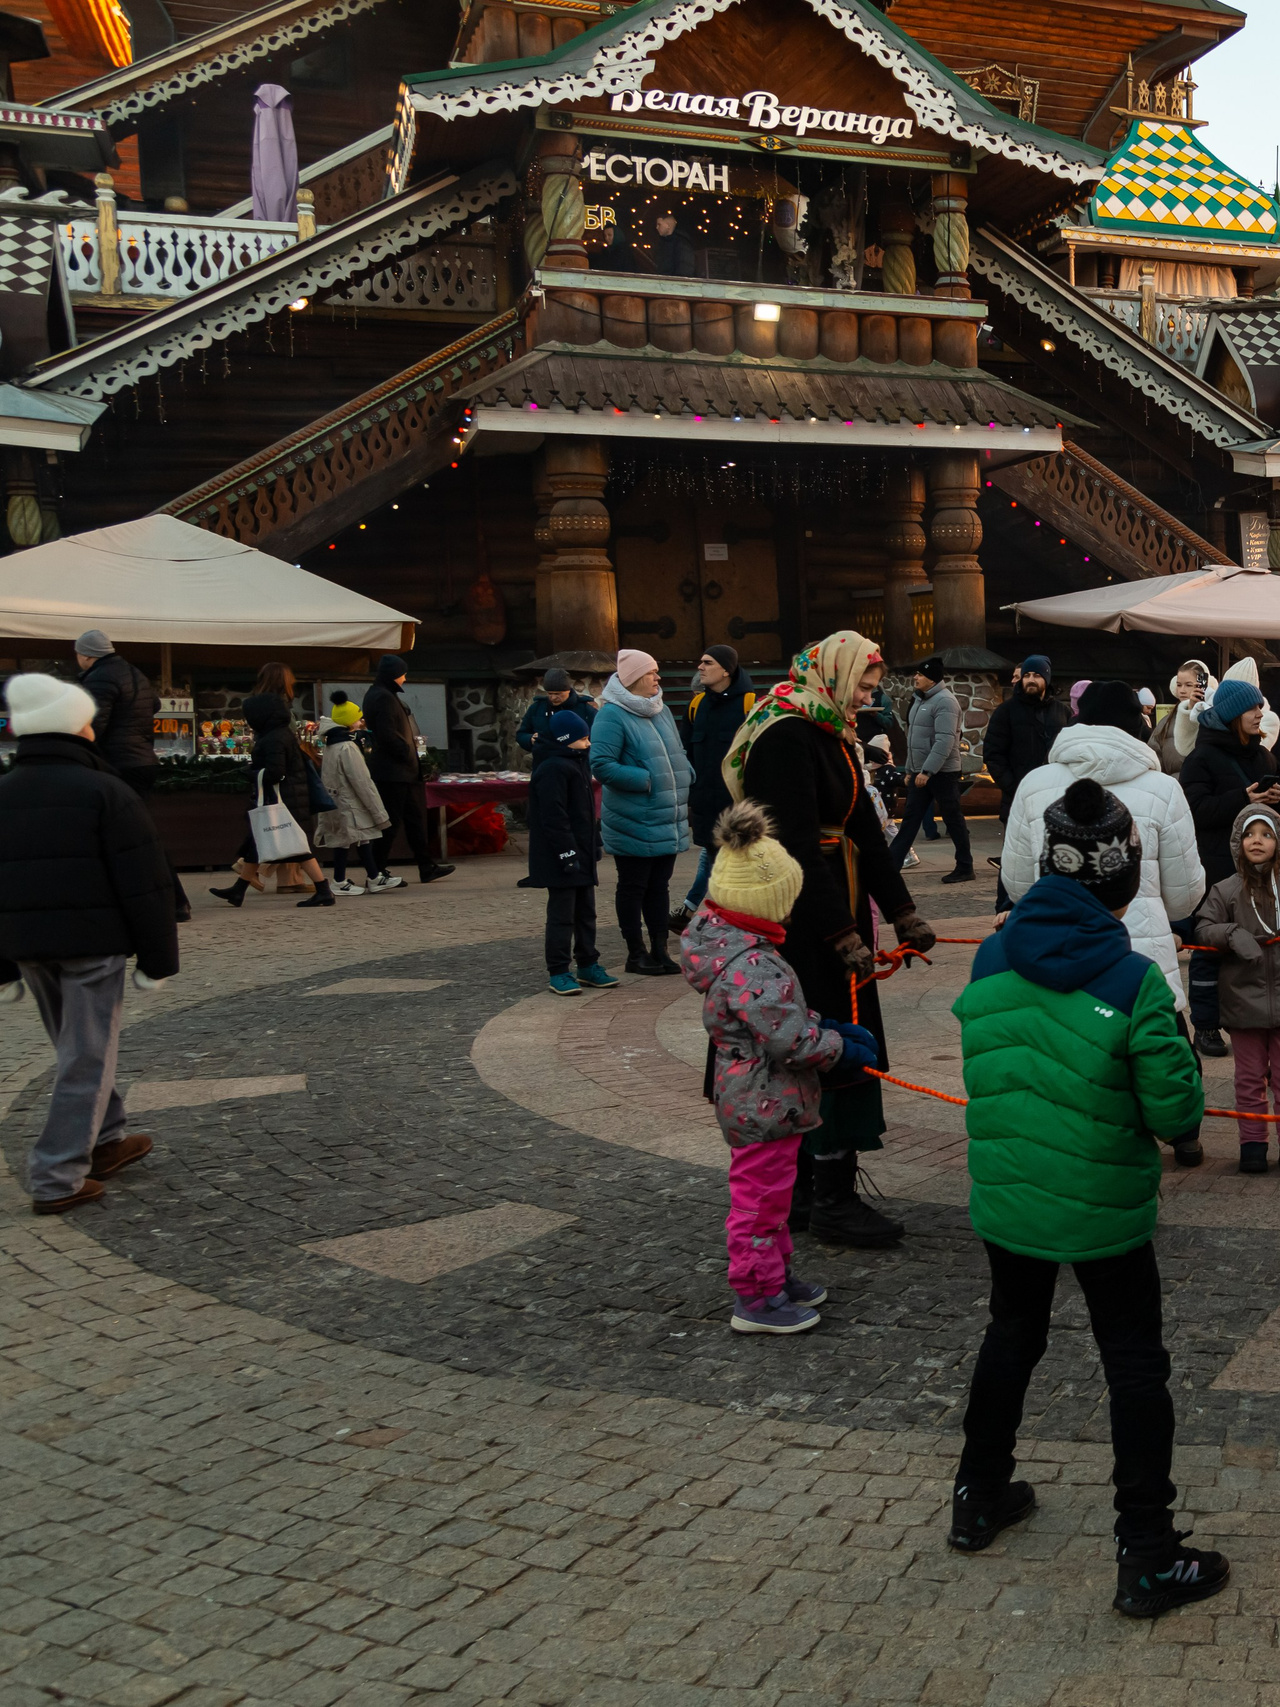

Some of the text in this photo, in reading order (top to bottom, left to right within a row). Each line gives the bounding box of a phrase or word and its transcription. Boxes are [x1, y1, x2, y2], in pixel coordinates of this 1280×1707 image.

[610, 88, 914, 145] Белая Веранда
[153, 719, 178, 733] 200
[263, 821, 292, 833] HARMONY
[559, 849, 577, 860] FILA
